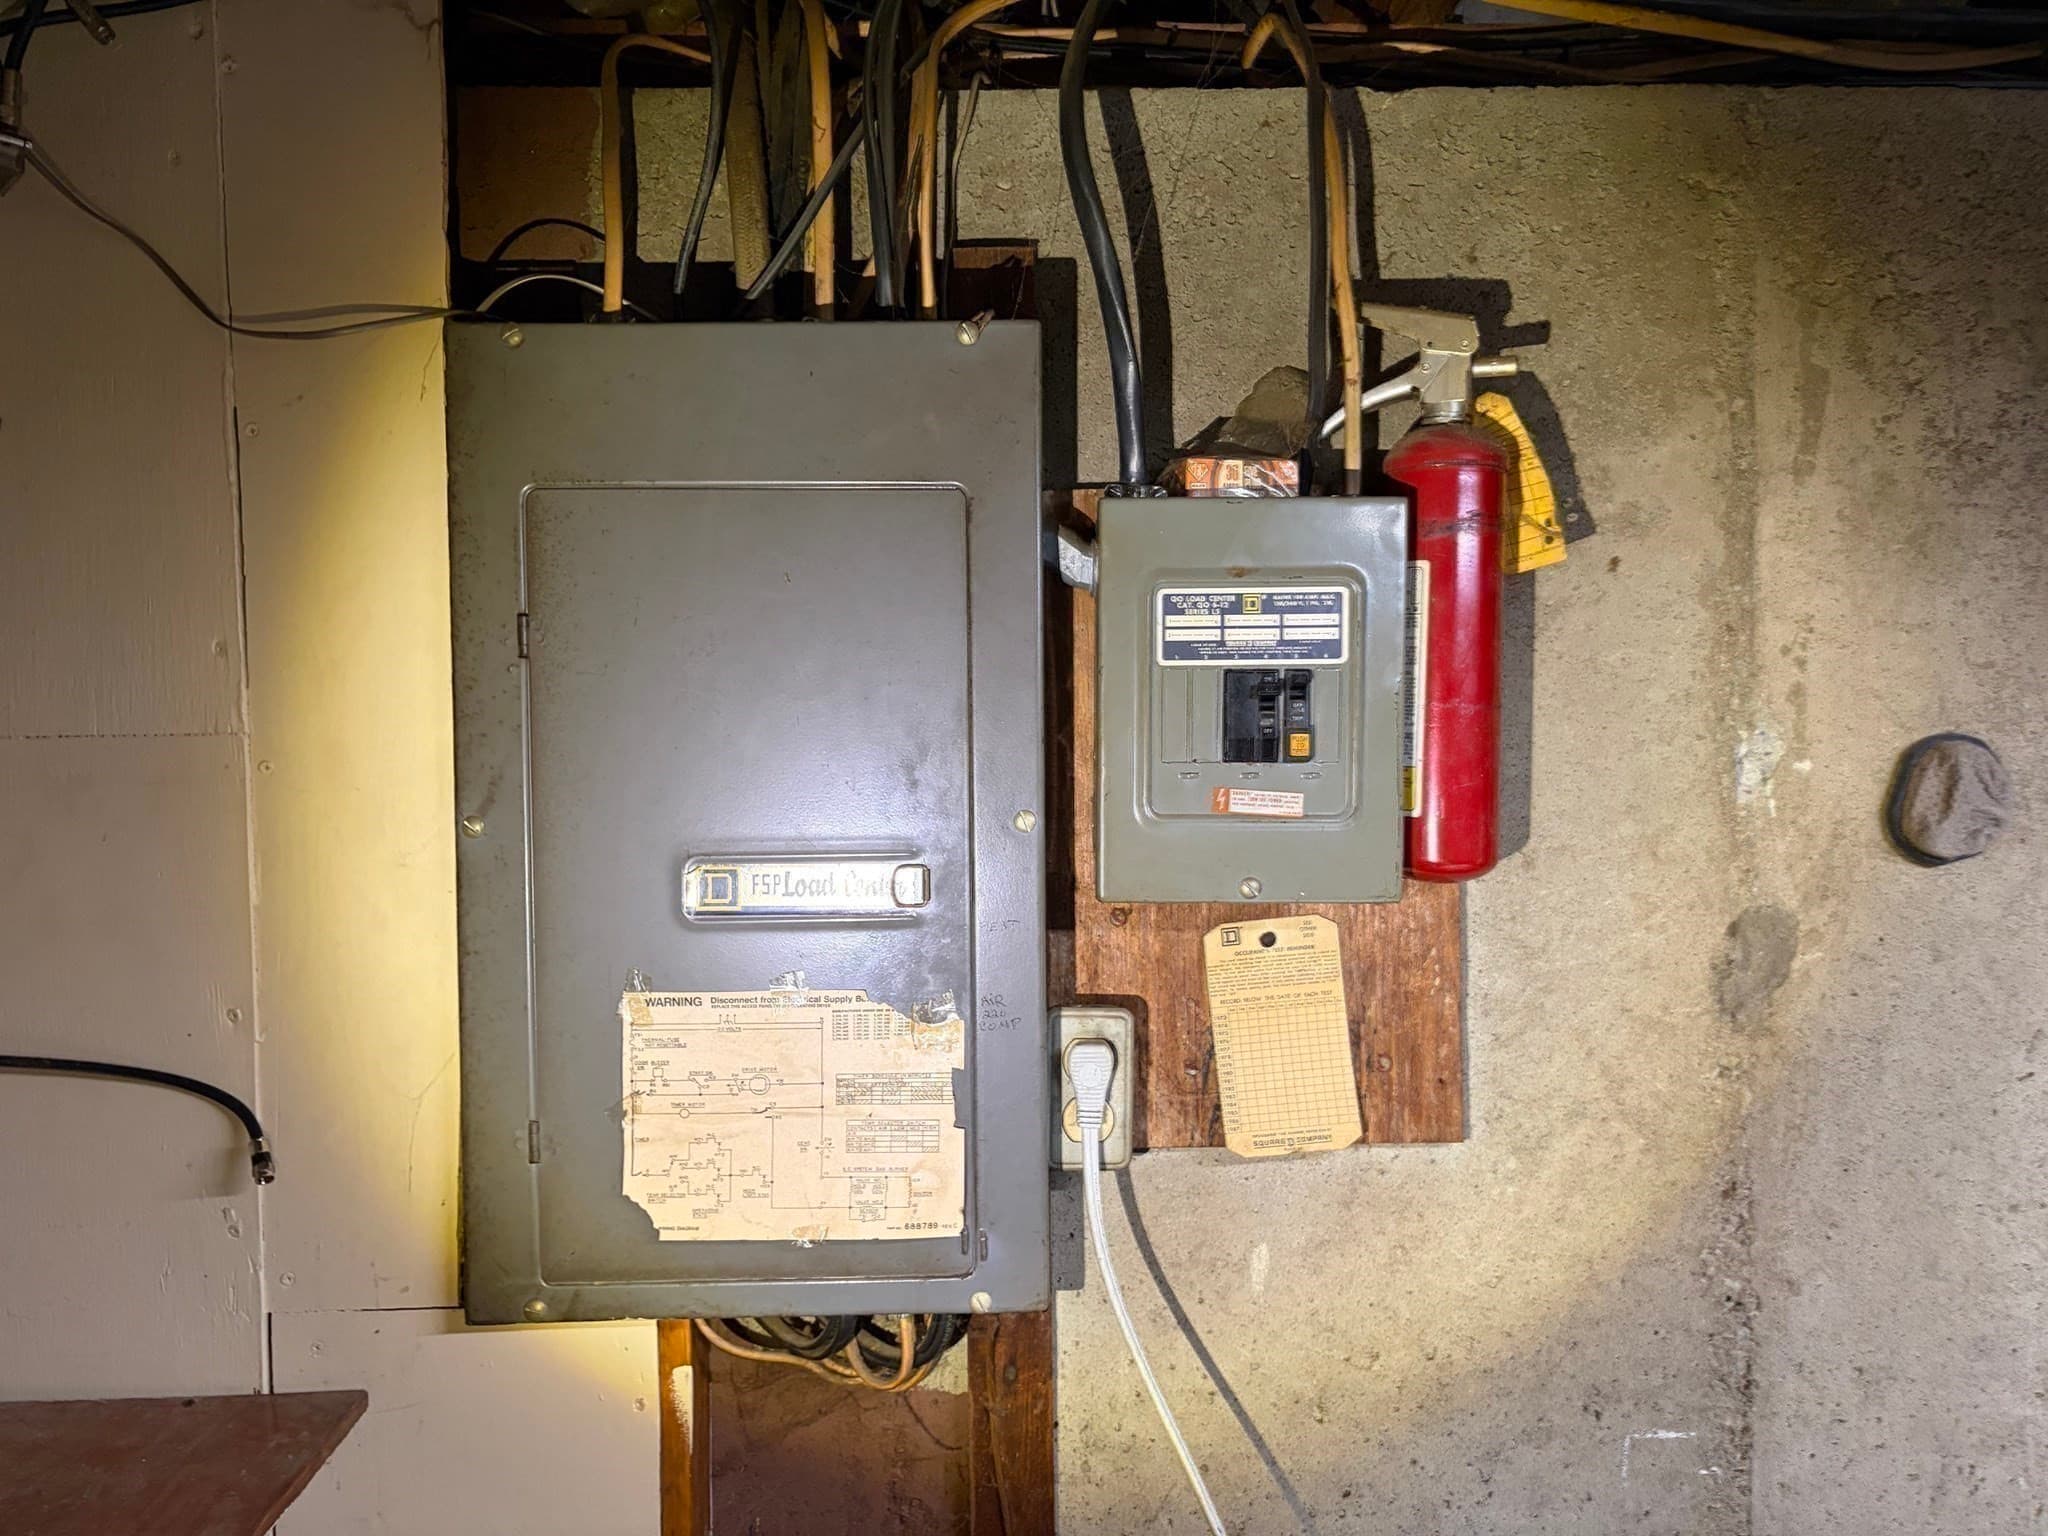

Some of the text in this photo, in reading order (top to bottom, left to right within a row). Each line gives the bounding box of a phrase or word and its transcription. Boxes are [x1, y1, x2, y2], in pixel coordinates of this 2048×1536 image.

[752, 873, 782, 895] FSP
[782, 871, 834, 897] Load
[645, 996, 703, 1007] WARNING
[710, 996, 758, 1004] Disconnect
[760, 996, 780, 1004] from
[782, 995, 821, 1004] Elecical
[823, 995, 853, 1006] Supply
